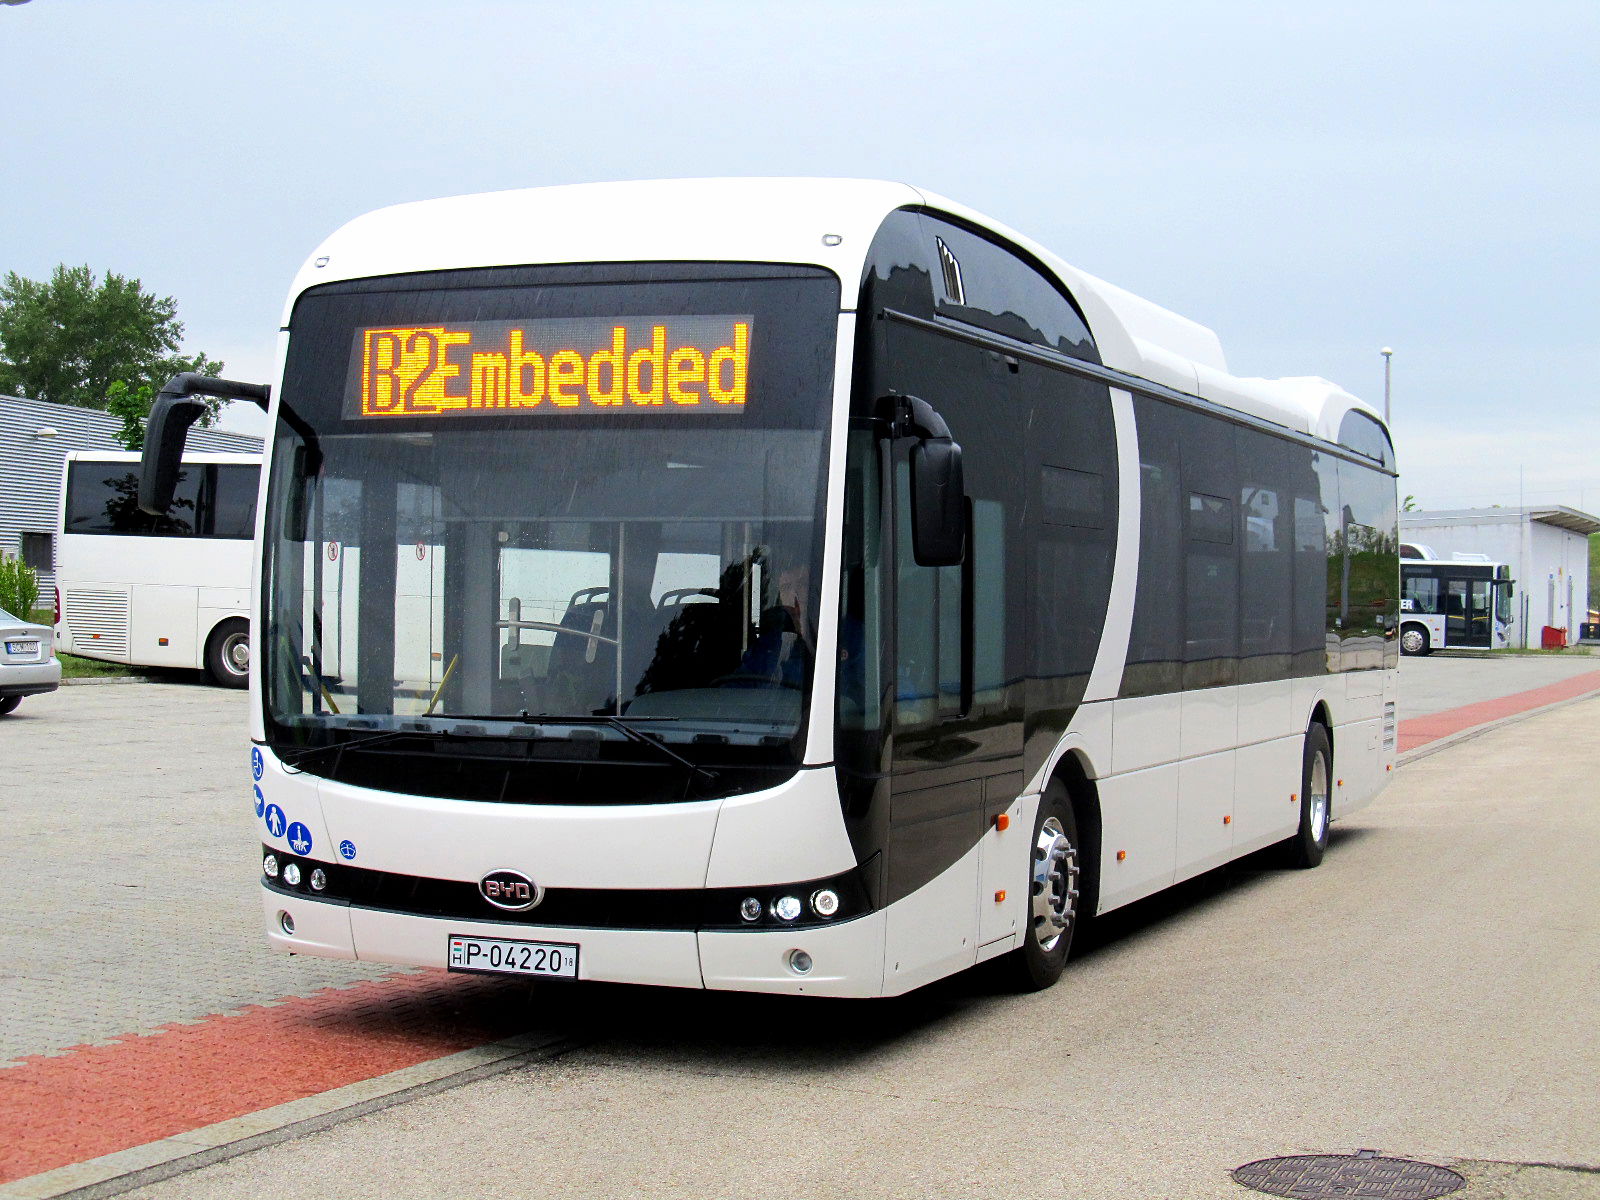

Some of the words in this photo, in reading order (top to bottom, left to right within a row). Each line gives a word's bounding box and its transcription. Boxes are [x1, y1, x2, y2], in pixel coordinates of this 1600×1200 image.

[485, 881, 530, 899] BYD
[452, 954, 463, 964] H
[466, 943, 562, 972] P-04220
